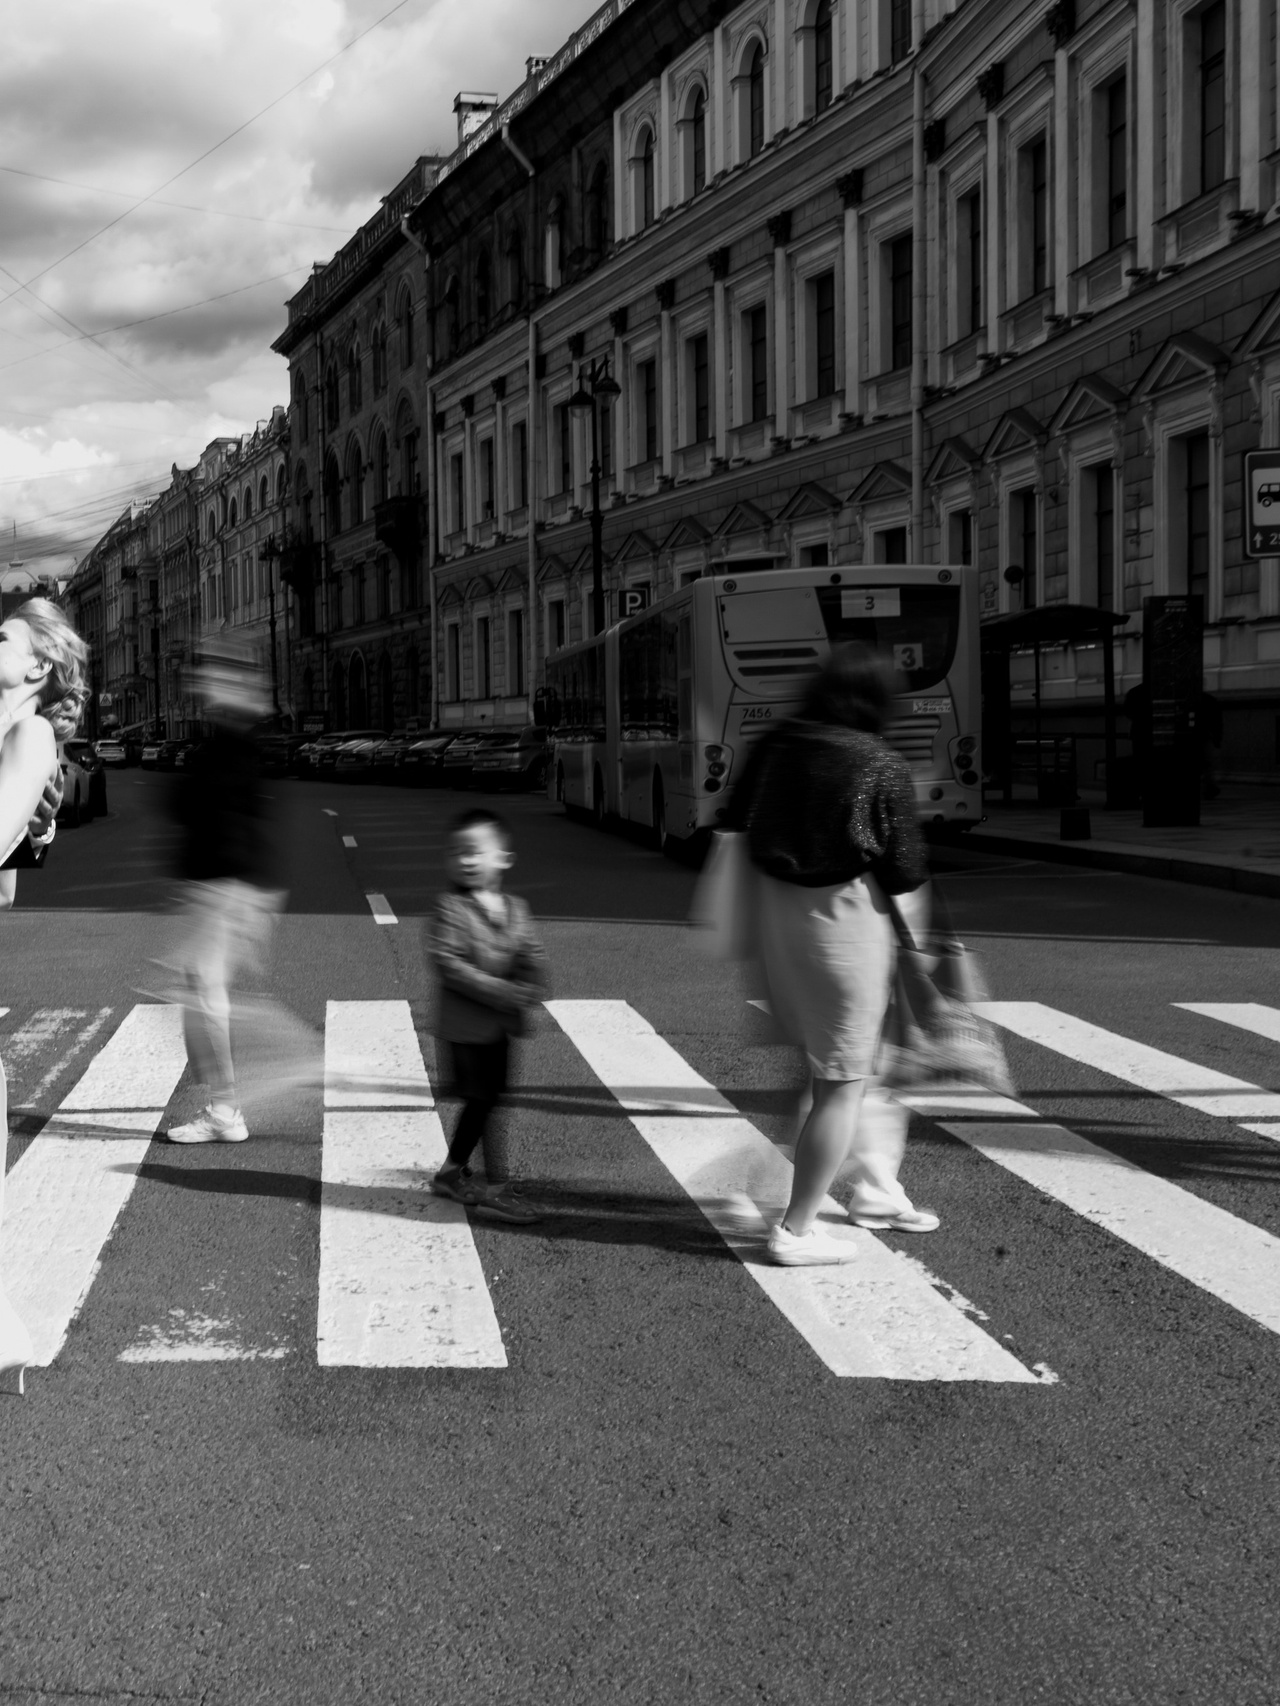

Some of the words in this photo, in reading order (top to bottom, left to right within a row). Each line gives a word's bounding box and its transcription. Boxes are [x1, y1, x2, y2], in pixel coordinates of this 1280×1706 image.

[625, 592, 642, 616] P
[865, 596, 875, 610] 3
[901, 647, 916, 668] 3
[742, 707, 772, 719] 7456
